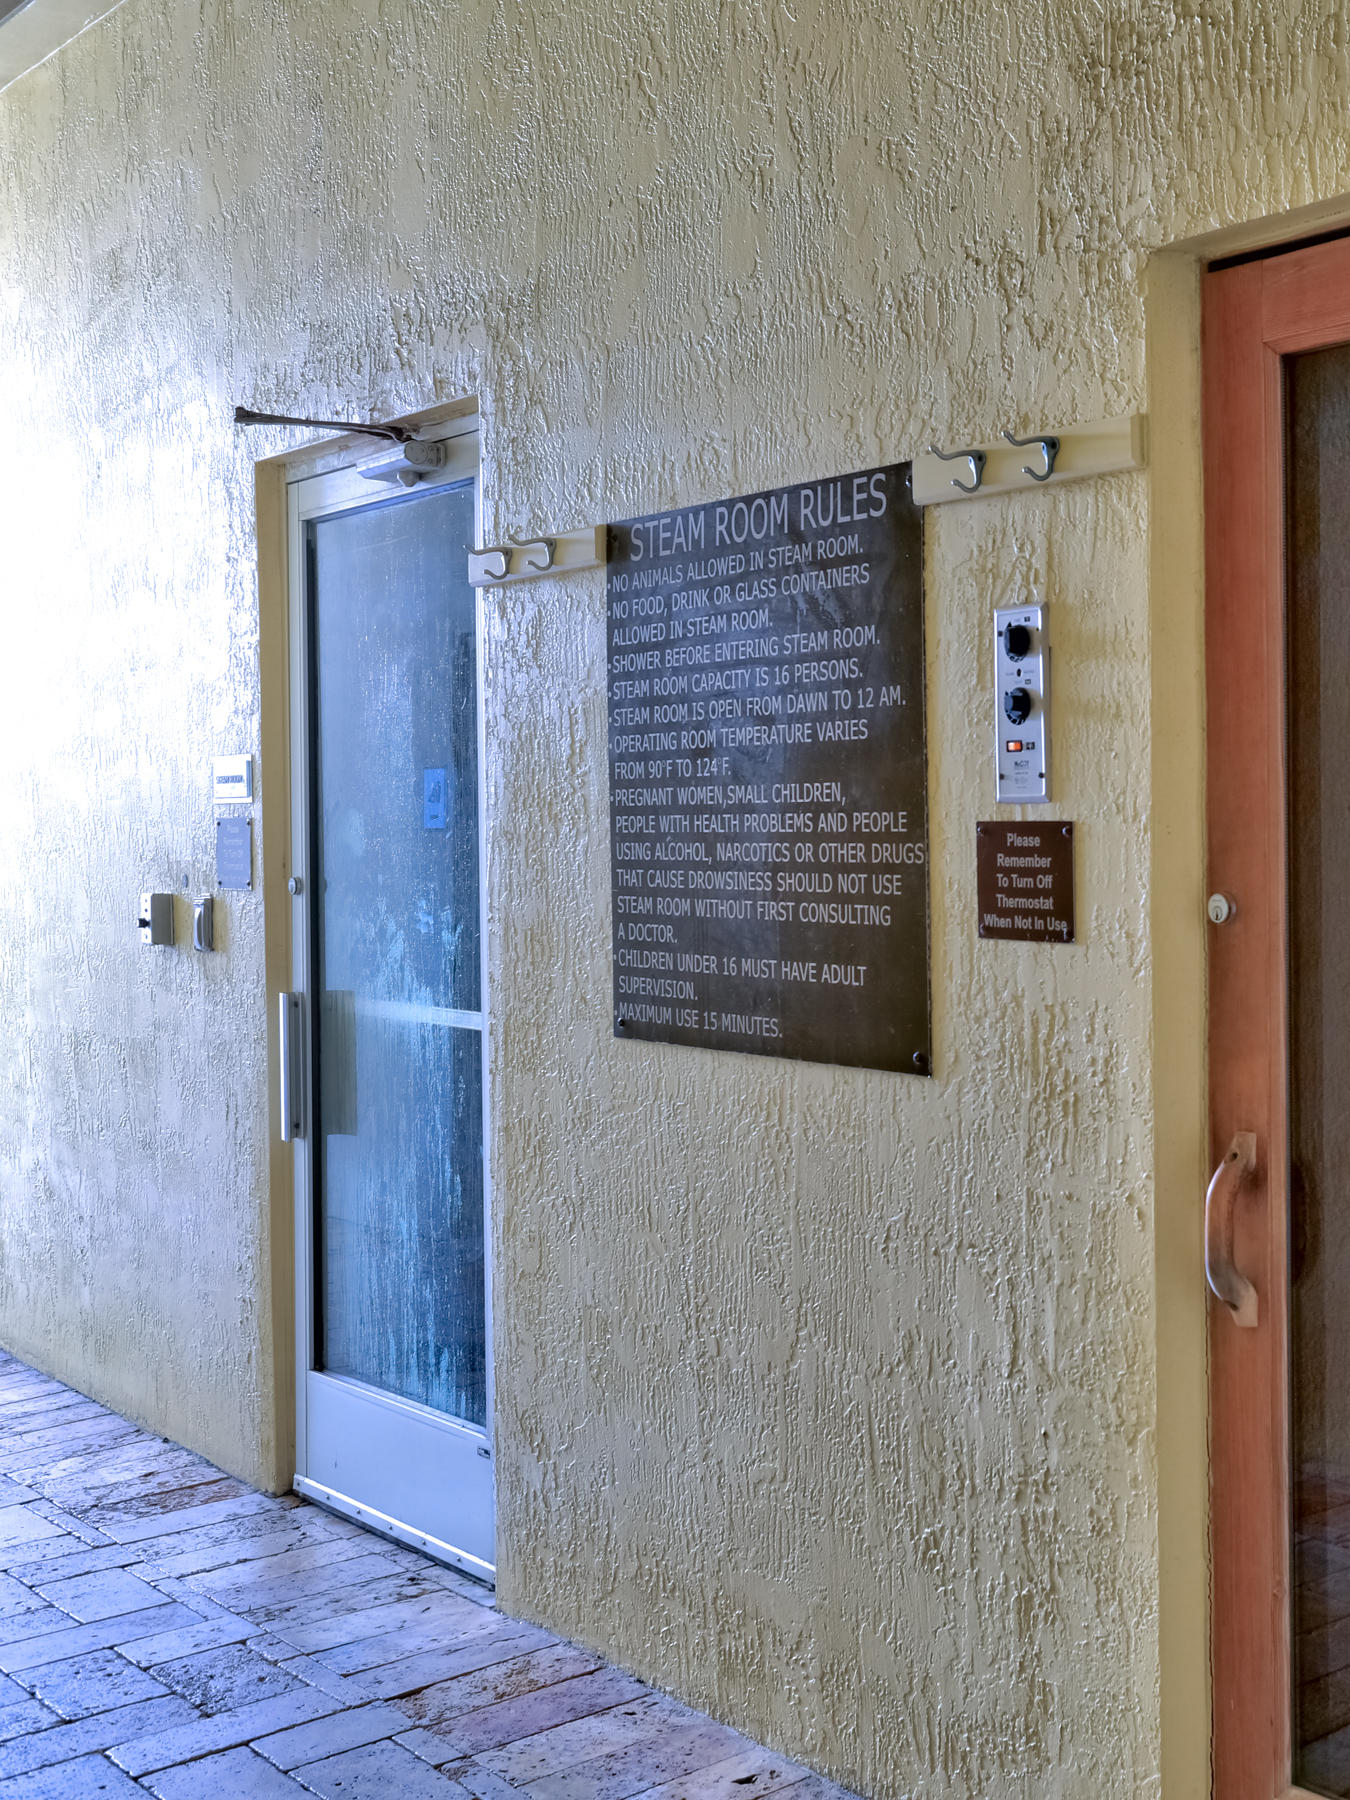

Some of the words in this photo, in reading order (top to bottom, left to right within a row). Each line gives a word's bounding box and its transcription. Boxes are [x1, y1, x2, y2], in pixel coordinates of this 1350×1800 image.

[630, 511, 704, 561] STEAM
[716, 493, 789, 546] ROOM
[800, 473, 887, 530] RULES
[612, 574, 628, 592] NO
[632, 565, 683, 589] ANIMALS
[687, 554, 745, 581] ALLOWED
[750, 551, 763, 571] IN
[769, 542, 812, 567] STEAM
[817, 534, 863, 560] ROOM.
[612, 602, 628, 619] NO
[632, 595, 667, 617] FOOD,
[672, 588, 709, 611] DRINK
[714, 587, 730, 605] OR
[736, 578, 776, 601] GLASS
[782, 564, 870, 594] CONTAINERS
[612, 621, 665, 646] ALLOWED
[670, 620, 682, 639] IN
[687, 613, 727, 636] STEAM
[731, 608, 773, 630] ROOM.
[613, 651, 661, 673] SHOWER
[666, 644, 710, 667] BEFORE
[715, 637, 778, 661] ENTERING
[783, 630, 828, 653] STEAM
[834, 625, 879, 647] ROOM.
[613, 680, 649, 699] STEAM
[654, 676, 687, 696] ROOM
[692, 669, 751, 692] CAPACITY
[755, 667, 769, 686] IS
[774, 666, 789, 685] 16
[795, 658, 863, 683] PERSONS.
[614, 707, 650, 726] STEAM
[654, 704, 688, 724] ROOM
[692, 702, 705, 721] IS
[709, 699, 741, 720] OPEN
[747, 695, 782, 717] FROM
[787, 692, 828, 714] DAWN
[832, 690, 850, 709] TO
[857, 688, 873, 708] 12
[880, 685, 905, 706] AM.
[614, 731, 677, 753] OPERATING
[682, 729, 716, 749] ROOM
[722, 722, 812, 747] TEMPERATURE
[817, 719, 868, 742] VARIES
[615, 762, 644, 779] FROM
[676, 759, 691, 777] TO
[616, 788, 674, 807] PREGNANT
[772, 782, 846, 806] CHILDREN,
[616, 816, 655, 833] PEOPLE
[659, 815, 689, 833] WITH
[695, 815, 739, 833] HEALTH
[744, 814, 813, 832] PROBLEMS
[818, 813, 847, 832] AND
[853, 812, 907, 832] PEOPLE
[1007, 833, 1040, 846] Please
[617, 843, 650, 861] USING
[655, 843, 712, 864] ALCOHOL,
[717, 843, 790, 862] NARCOTICS
[795, 844, 814, 862] OR
[819, 844, 866, 863] OTHER
[872, 844, 924, 863] DRUGS
[997, 853, 1052, 867] Remember
[617, 869, 643, 887] THAT
[647, 870, 684, 889] CAUSE
[689, 871, 772, 891] DROWSINESS
[777, 873, 832, 893] SHOULD
[838, 874, 867, 894] NOT
[872, 875, 902, 895] USE
[996, 874, 1008, 887] To
[1011, 874, 1033, 888] Turn
[1036, 875, 1053, 888] Off
[617, 897, 652, 915] STEAM
[657, 898, 690, 917] ROOM
[695, 899, 752, 920] WITHOUT
[757, 901, 794, 921] FIRST
[800, 903, 891, 926] CONSULTING
[996, 894, 1054, 910] Thermostat
[618, 922, 625, 940] A
[629, 923, 677, 943] DOCTOR.
[984, 914, 1012, 928] When
[1015, 916, 1032, 929] Not
[1035, 917, 1044, 930] In
[1047, 918, 1067, 931] Use
[618, 950, 673, 971] CHILDREN
[678, 954, 718, 974] UNDER
[723, 957, 737, 976] 16
[742, 958, 777, 979] MUST
[782, 961, 816, 982] HAVE
[821, 965, 866, 986] ADULT
[619, 976, 698, 1000] SUPERVISION.
[619, 1003, 672, 1025] MAXIMUM
[676, 1009, 699, 1028] USE
[704, 1012, 717, 1031] 15
[722, 1014, 782, 1038] MINUTES.
